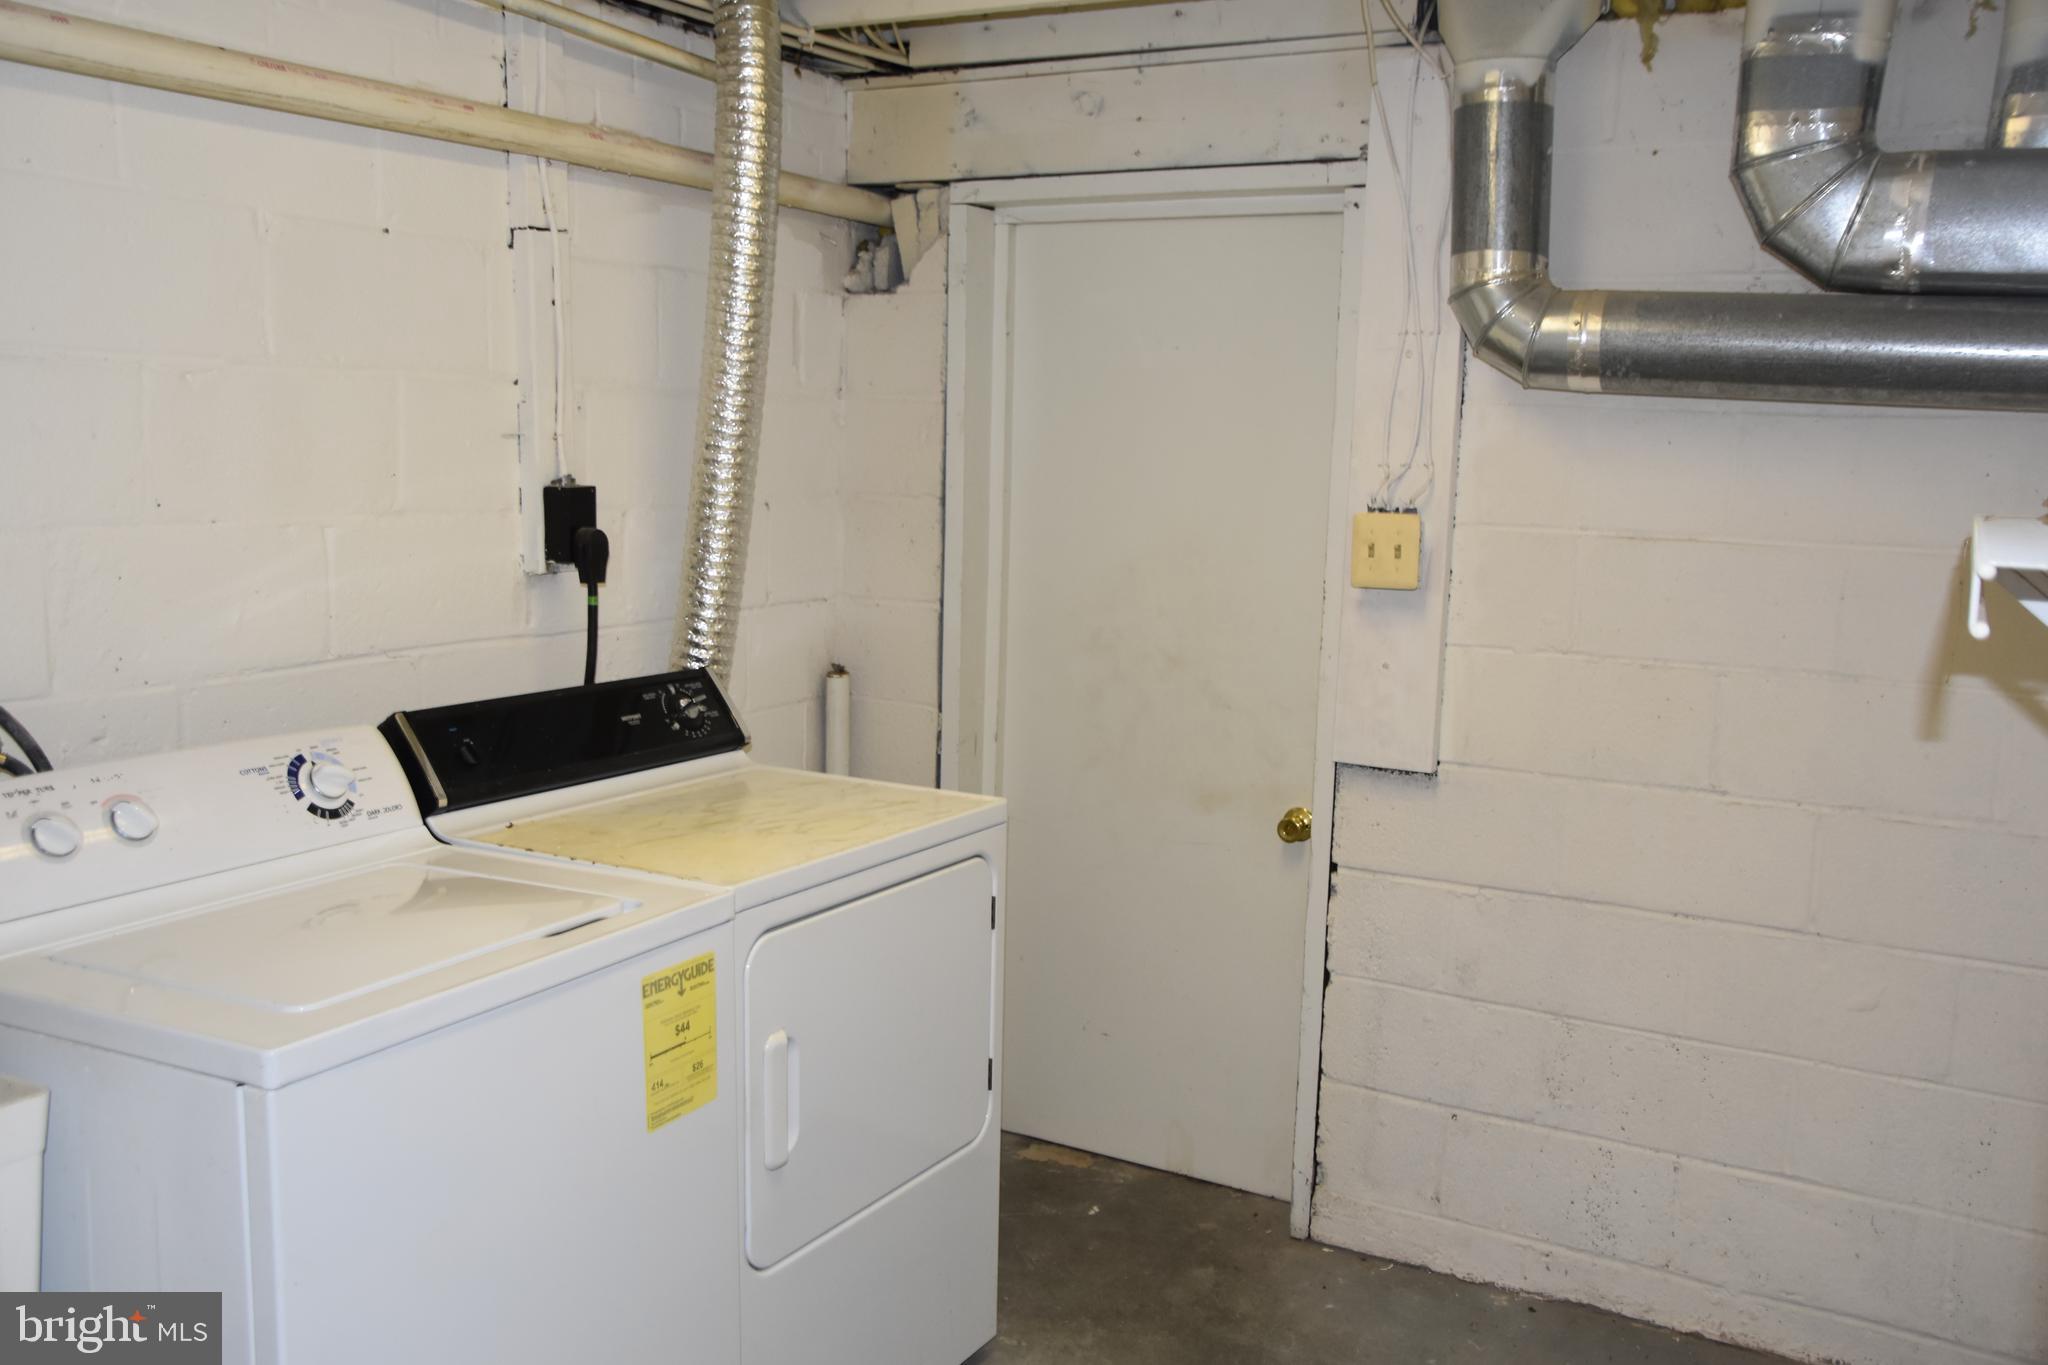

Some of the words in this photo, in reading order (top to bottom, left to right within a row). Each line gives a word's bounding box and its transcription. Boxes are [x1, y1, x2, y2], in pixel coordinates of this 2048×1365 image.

[367, 808, 381, 817] DARK
[642, 958, 715, 999] ENERGYGUIDE
[675, 1019, 690, 1036] $44
